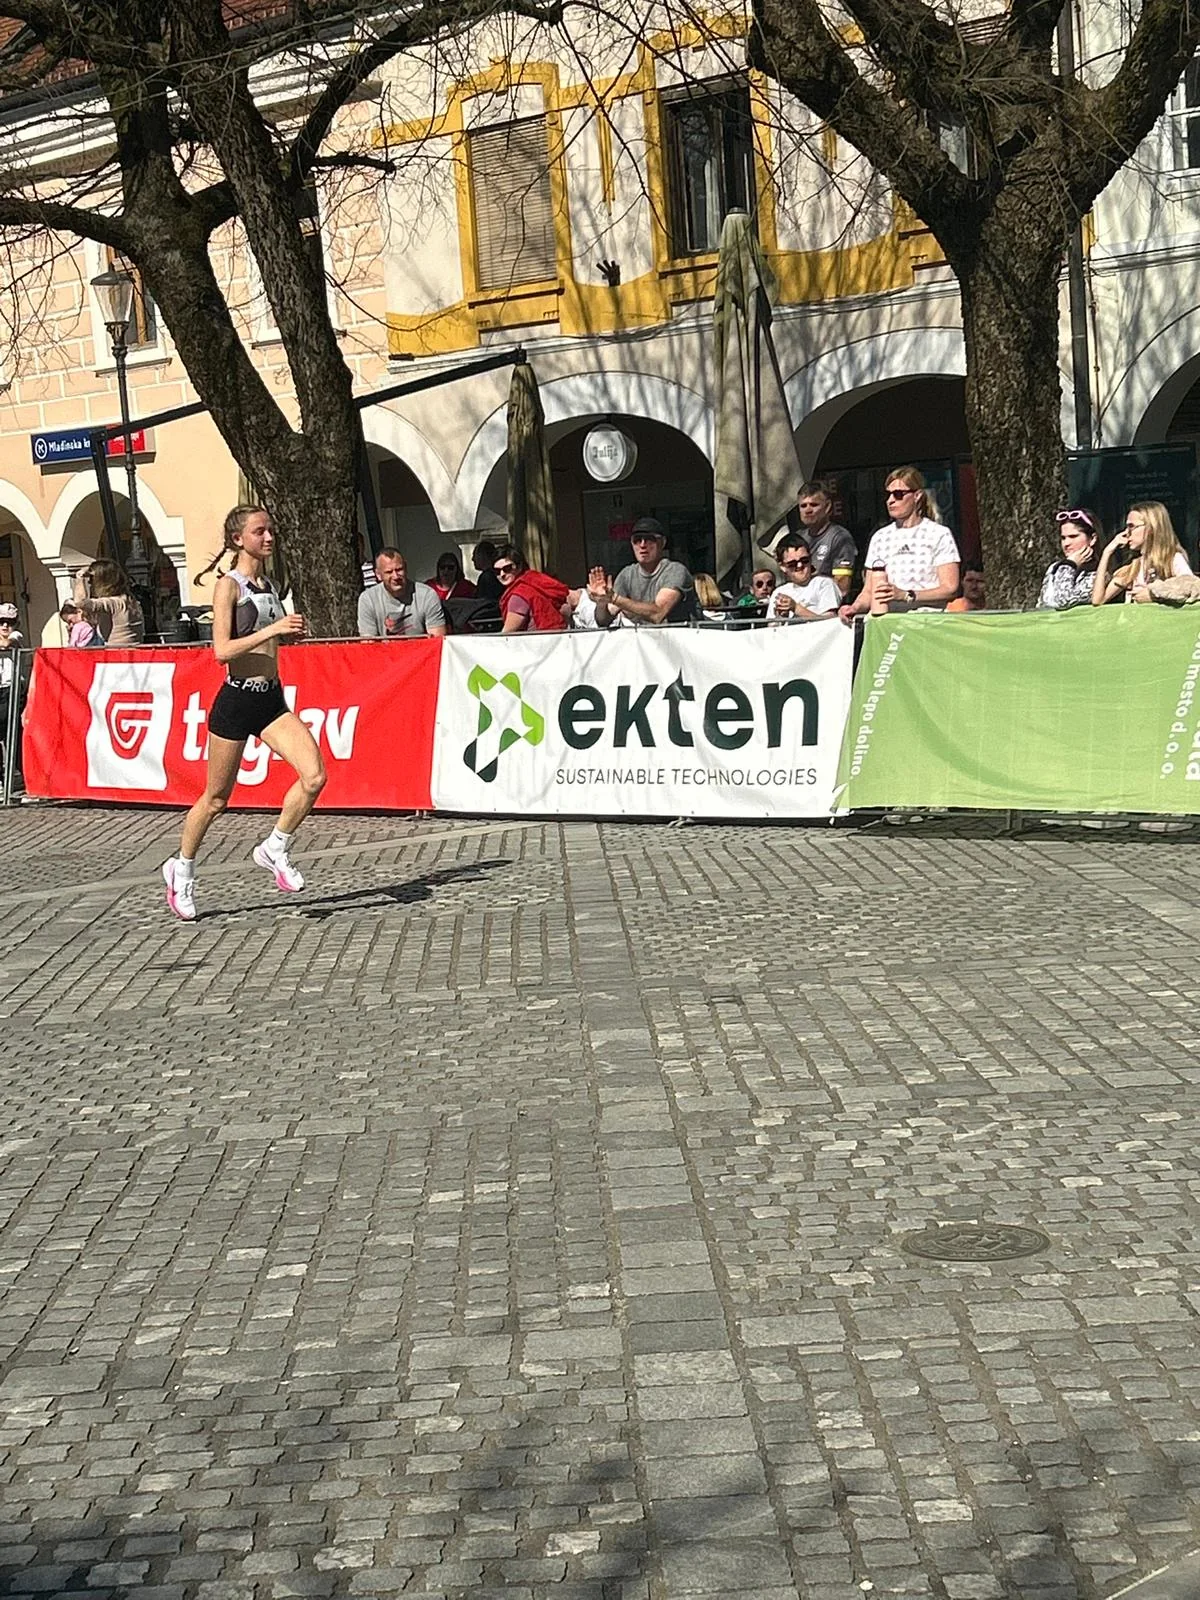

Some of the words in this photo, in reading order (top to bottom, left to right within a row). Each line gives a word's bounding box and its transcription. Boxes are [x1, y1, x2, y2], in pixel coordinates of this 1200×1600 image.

[268, 606, 276, 621] 4
[241, 679, 270, 693] PRO
[872, 652, 897, 688] mojo
[862, 690, 886, 722] lepo
[1175, 664, 1200, 718] mesto
[558, 667, 819, 750] ekten
[556, 768, 665, 785] SUSTAINABLE
[671, 768, 818, 786] TECHNOLOGIES
